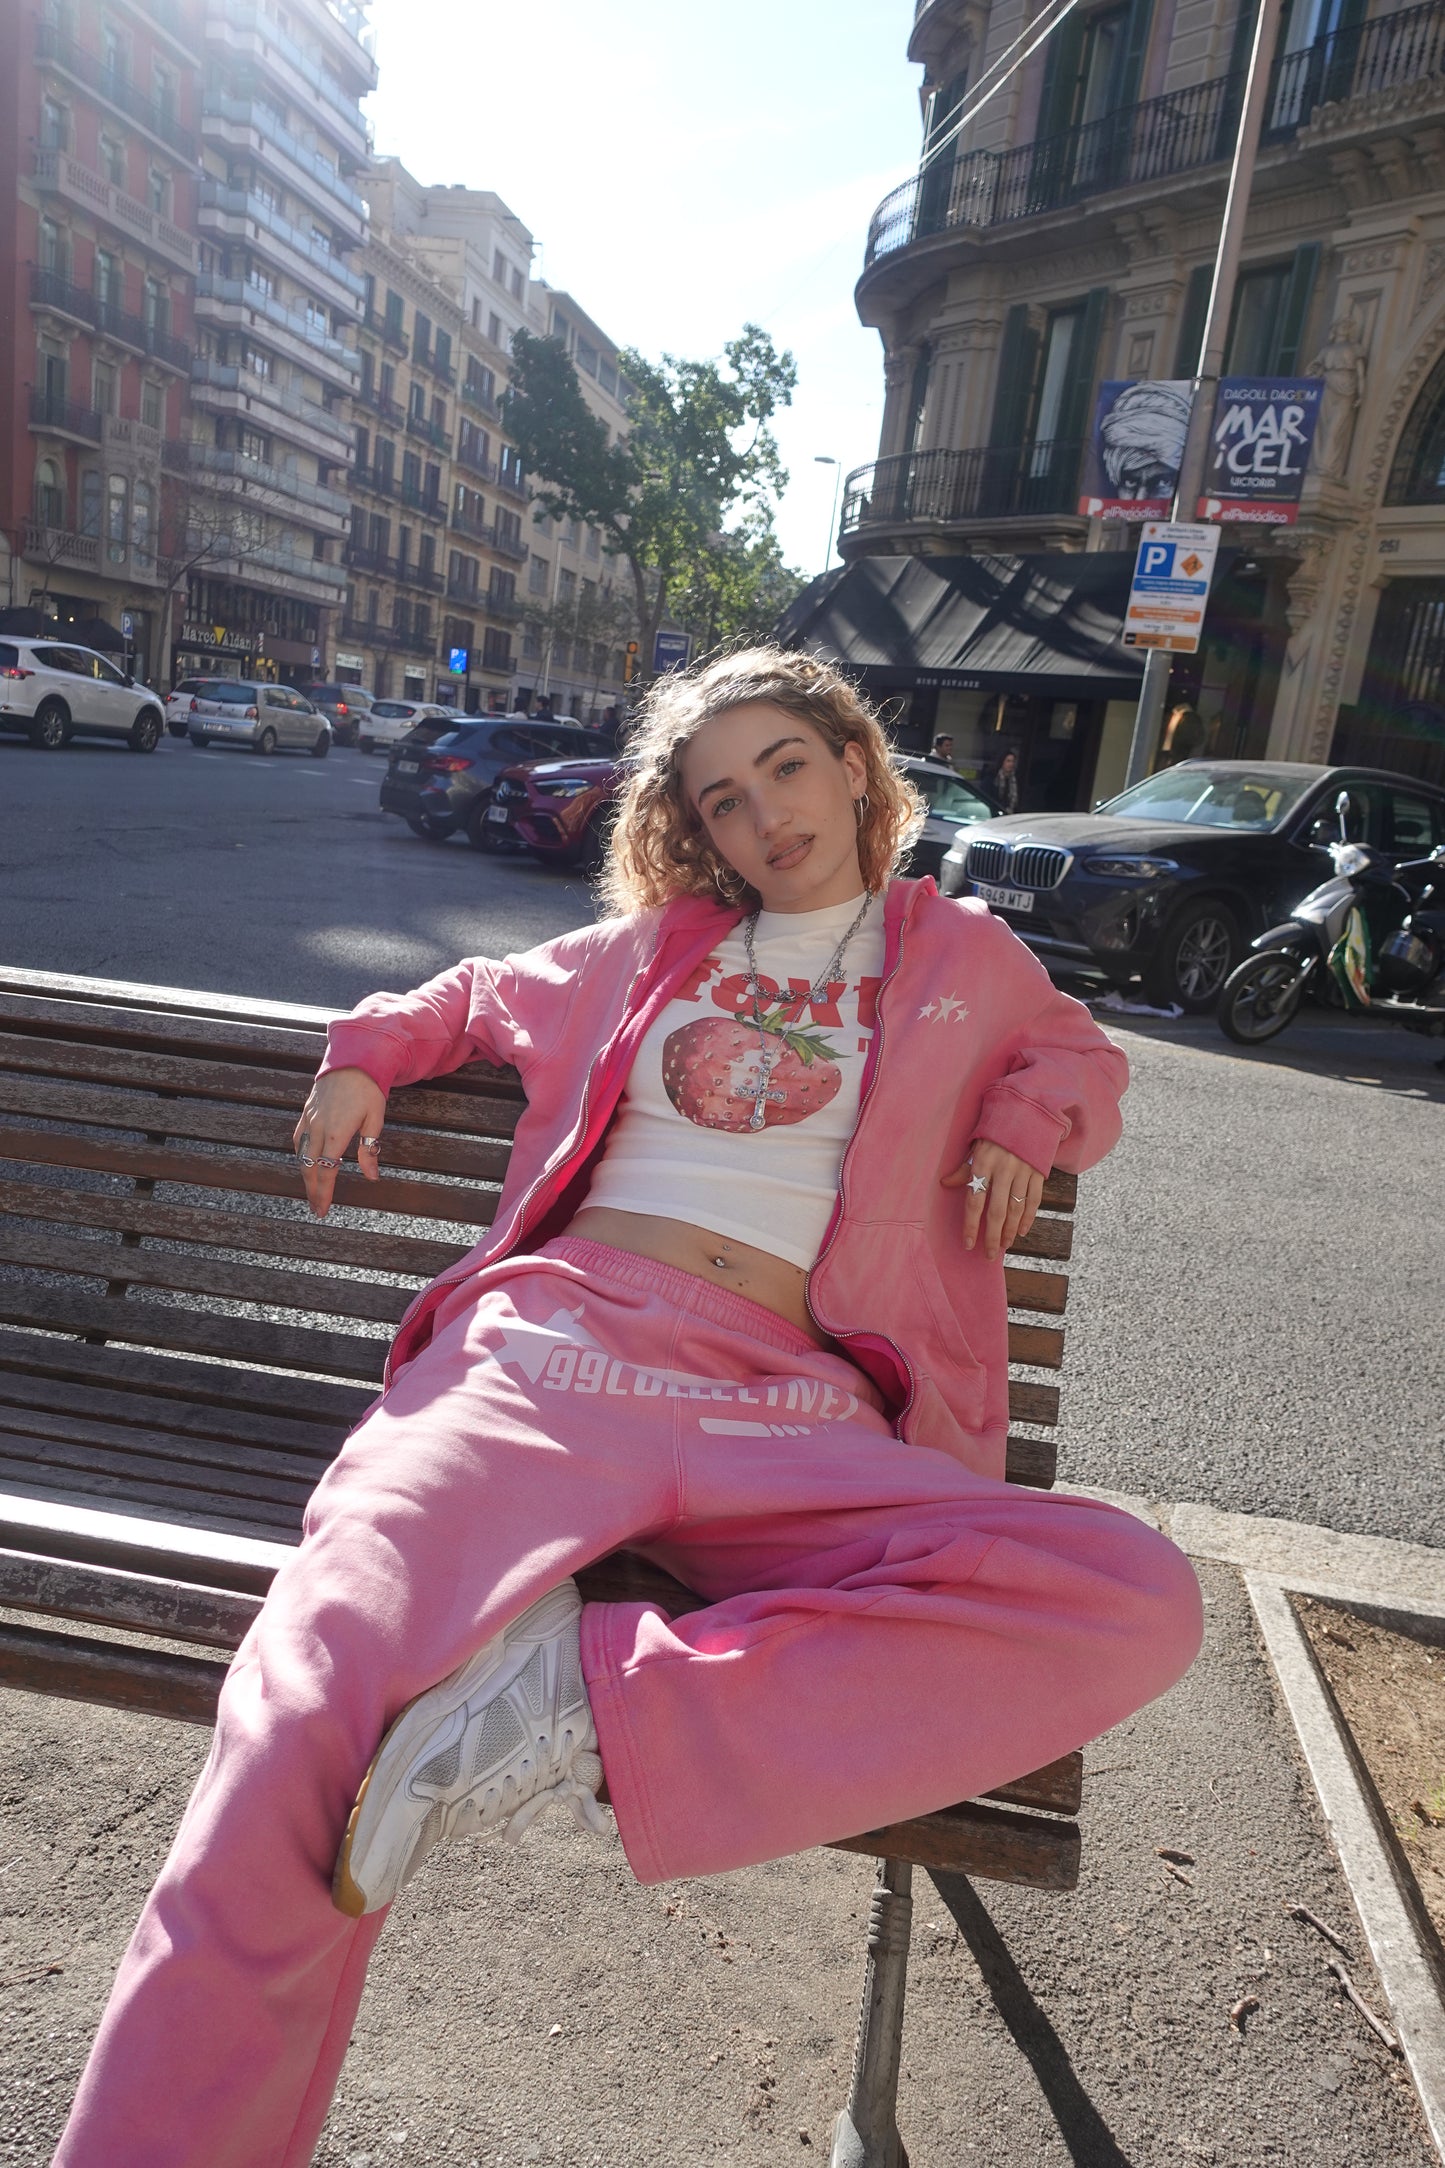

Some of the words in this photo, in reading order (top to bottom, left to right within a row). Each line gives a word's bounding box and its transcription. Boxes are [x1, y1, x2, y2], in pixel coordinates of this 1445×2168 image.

[1223, 389, 1267, 400] DAGOLL
[1215, 404, 1308, 444] MAR
[1144, 546, 1167, 574] P
[124, 616, 131, 631] P
[182, 624, 216, 644] Marco
[222, 632, 255, 652] Aldan
[980, 887, 1005, 904] 5948
